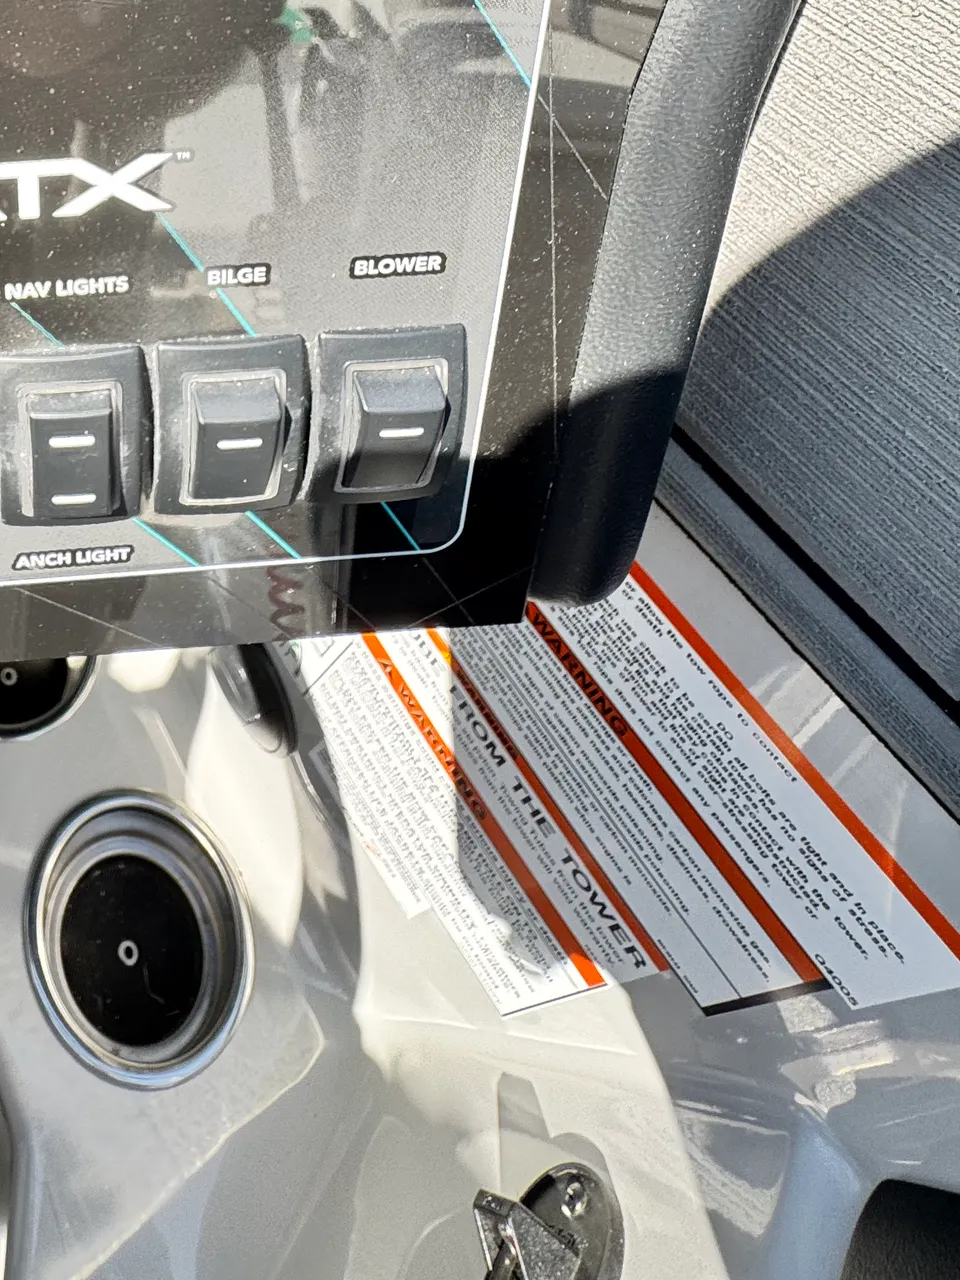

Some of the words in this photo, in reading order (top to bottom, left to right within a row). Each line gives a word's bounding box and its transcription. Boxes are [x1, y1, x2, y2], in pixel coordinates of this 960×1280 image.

[3, 280, 53, 301] NAV
[55, 275, 130, 297] LIGHTS
[206, 265, 268, 287] BILGE
[352, 254, 443, 277] BLOWER
[15, 549, 73, 570] ANCH
[75, 546, 133, 564] LIGHT
[531, 610, 629, 738] WARNING
[665, 629, 684, 648] the
[685, 653, 706, 675] tow
[707, 680, 733, 708] rope
[736, 713, 749, 726] to
[751, 732, 797, 782] contact
[398, 682, 489, 820] WARNING
[715, 721, 734, 740] DO
[447, 685, 508, 766] FROM
[509, 776, 556, 837] THE
[558, 848, 647, 969] TOWER
[655, 740, 691, 782] contact
[691, 787, 710, 807] any
[710, 812, 771, 887] passengers.
[675, 724, 698, 746] may
[700, 752, 728, 783] come
[729, 787, 741, 799] in
[742, 804, 784, 851] contact
[784, 856, 809, 883] with
[810, 888, 831, 910] the
[833, 916, 870, 959] tower.
[690, 716, 725, 755] certain
[726, 760, 757, 794] tower
[757, 798, 779, 821] has
[779, 826, 796, 842] no
[797, 847, 829, 882] signs
[831, 888, 847, 902] of
[847, 909, 890, 957] stress.
[697, 712, 733, 752] certain
[733, 757, 749, 770] all
[748, 774, 777, 805] bolts
[778, 811, 797, 831] are
[798, 836, 828, 866] tight
[828, 872, 854, 897] and
[853, 902, 868, 915] in
[866, 920, 907, 964] place.
[727, 798, 745, 817] are
[747, 822, 821, 910] unobstructed.
[556, 869, 579, 898] from
[579, 902, 596, 922] the
[595, 926, 624, 963] tower
[770, 863, 802, 899] tower
[804, 906, 818, 919] or
[814, 953, 859, 1007] Q4005
